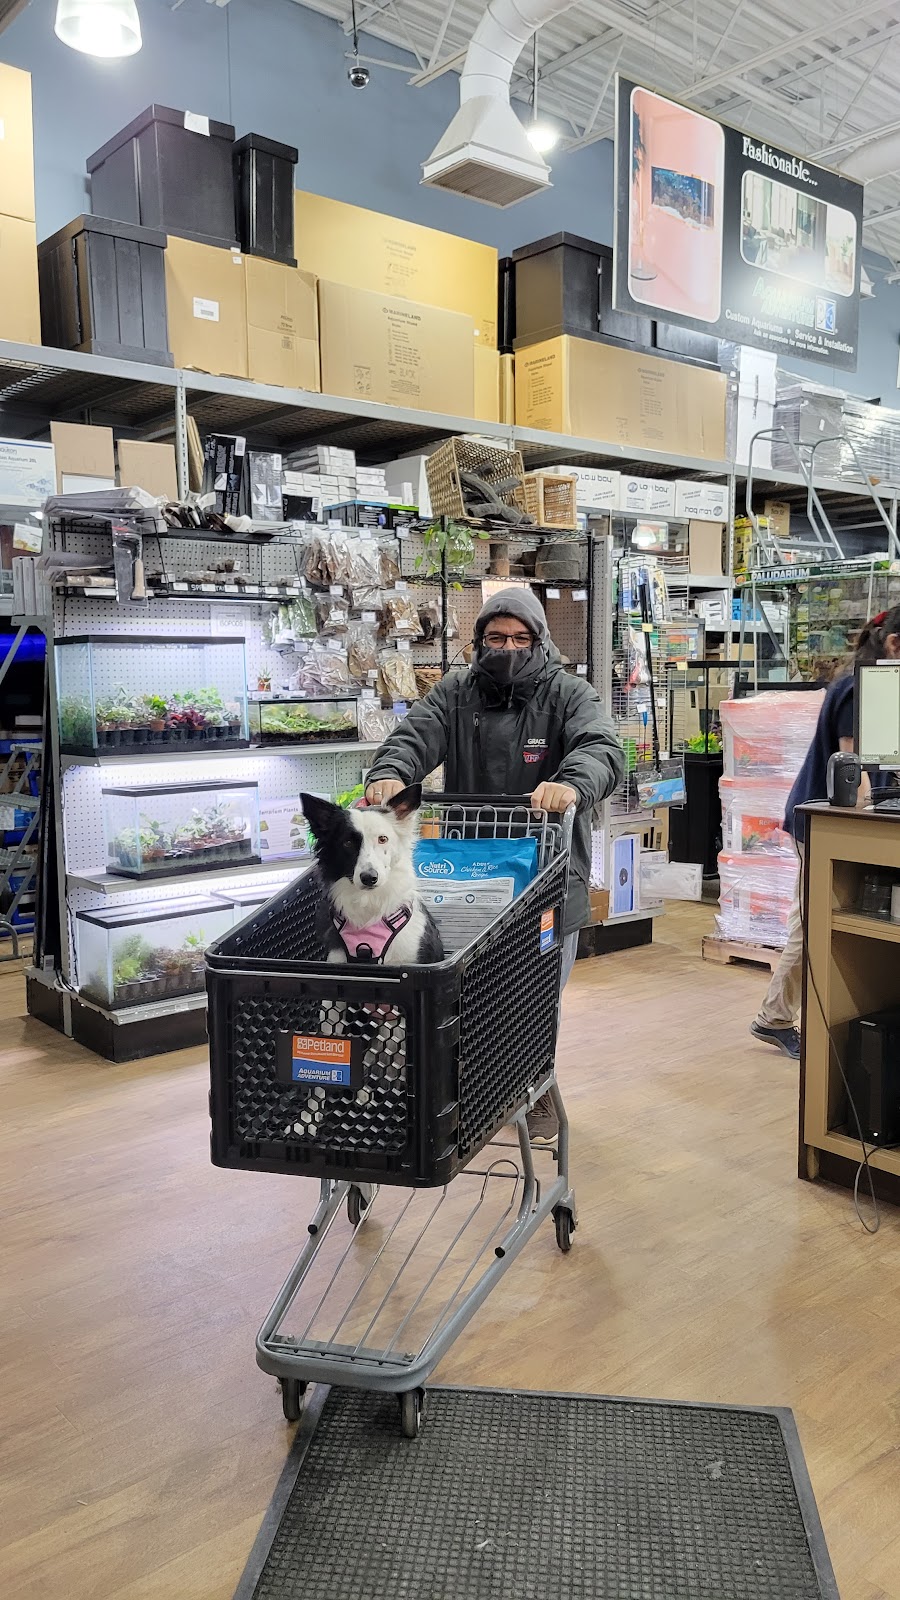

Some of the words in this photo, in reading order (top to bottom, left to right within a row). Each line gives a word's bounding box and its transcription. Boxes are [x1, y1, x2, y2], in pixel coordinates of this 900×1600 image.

[742, 136, 818, 186] Fashionable...
[725, 309, 750, 325] Custom
[751, 317, 783, 334] Aquariums
[794, 328, 817, 344] Service
[824, 337, 854, 354] Installation
[753, 329, 762, 337] Ask
[768, 333, 789, 344] associate
[796, 341, 806, 349] more
[751, 567, 810, 581] PALUDARIUM
[423, 866, 448, 874] Source
[429, 862, 447, 870] Nutri
[307, 1039, 344, 1052] Petland
